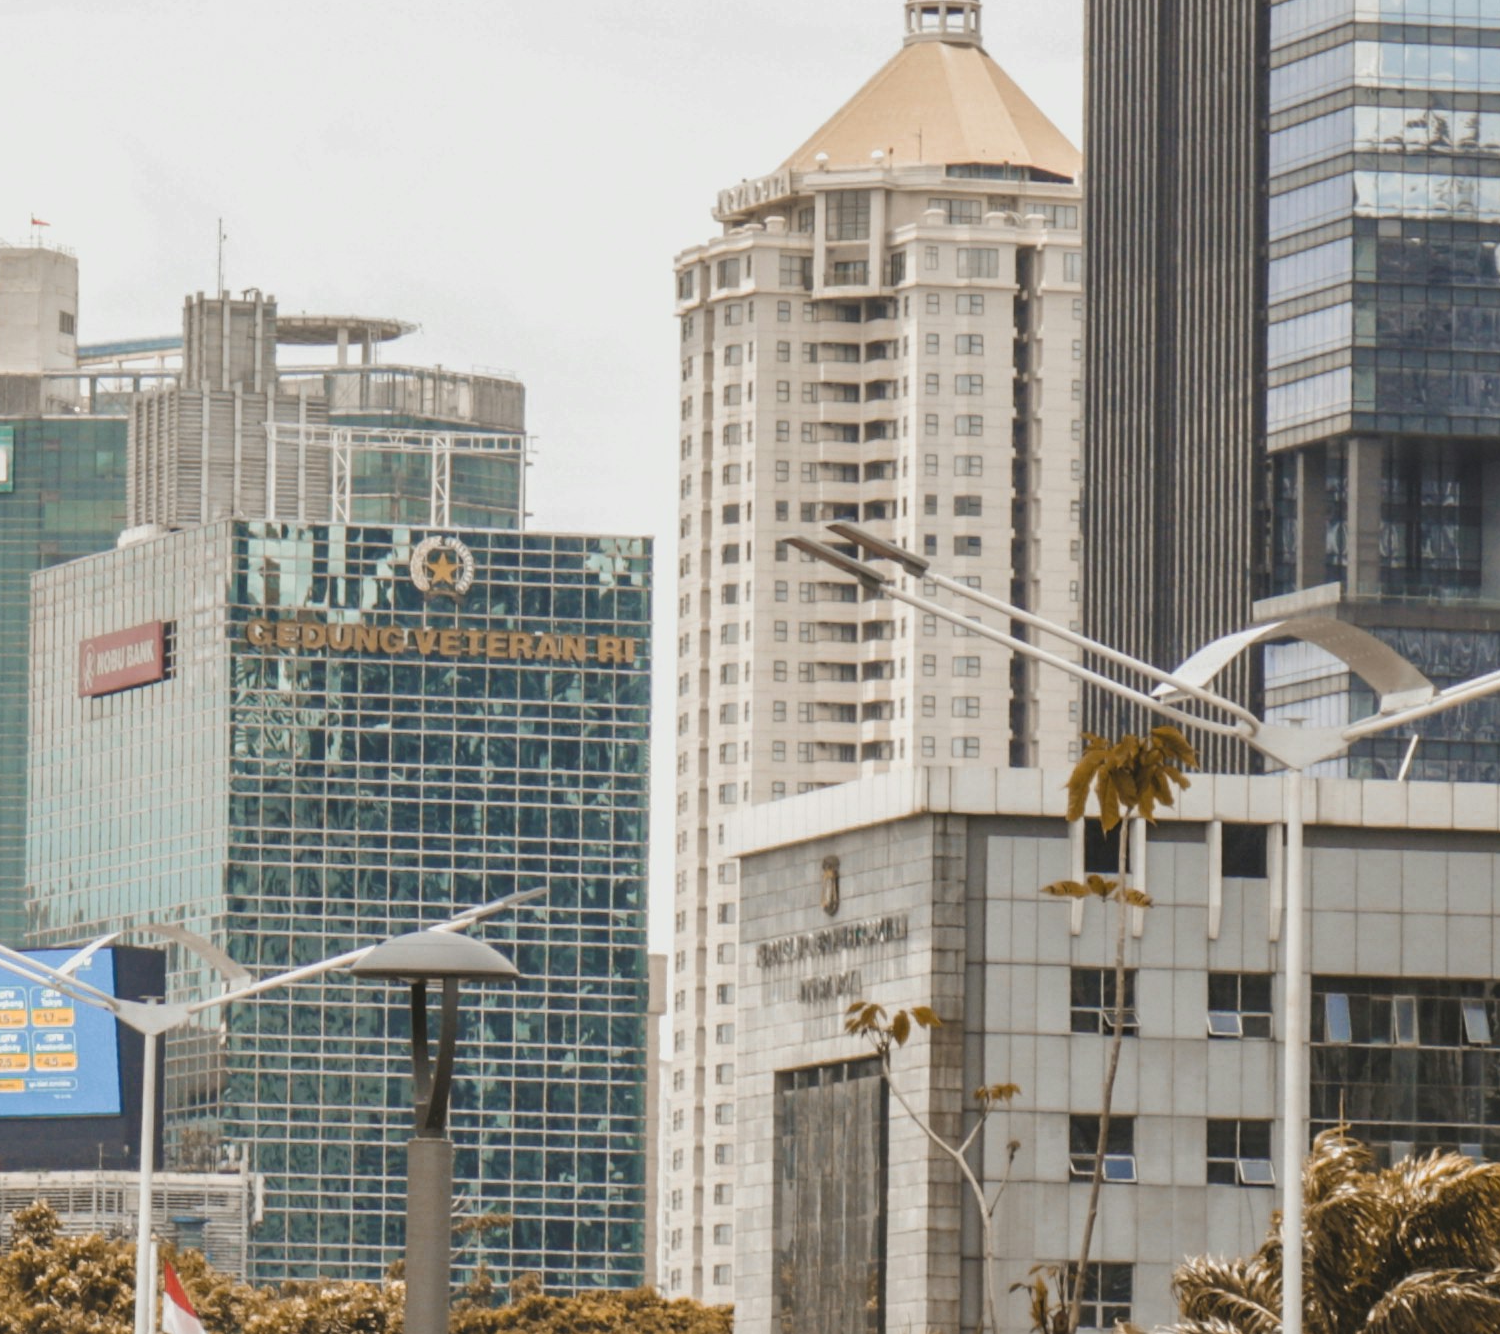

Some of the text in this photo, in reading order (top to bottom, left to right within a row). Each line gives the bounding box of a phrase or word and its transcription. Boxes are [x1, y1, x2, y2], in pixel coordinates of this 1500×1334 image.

[126, 639, 154, 668] BANK
[245, 619, 636, 663] GEDUNG VETERAN RI
